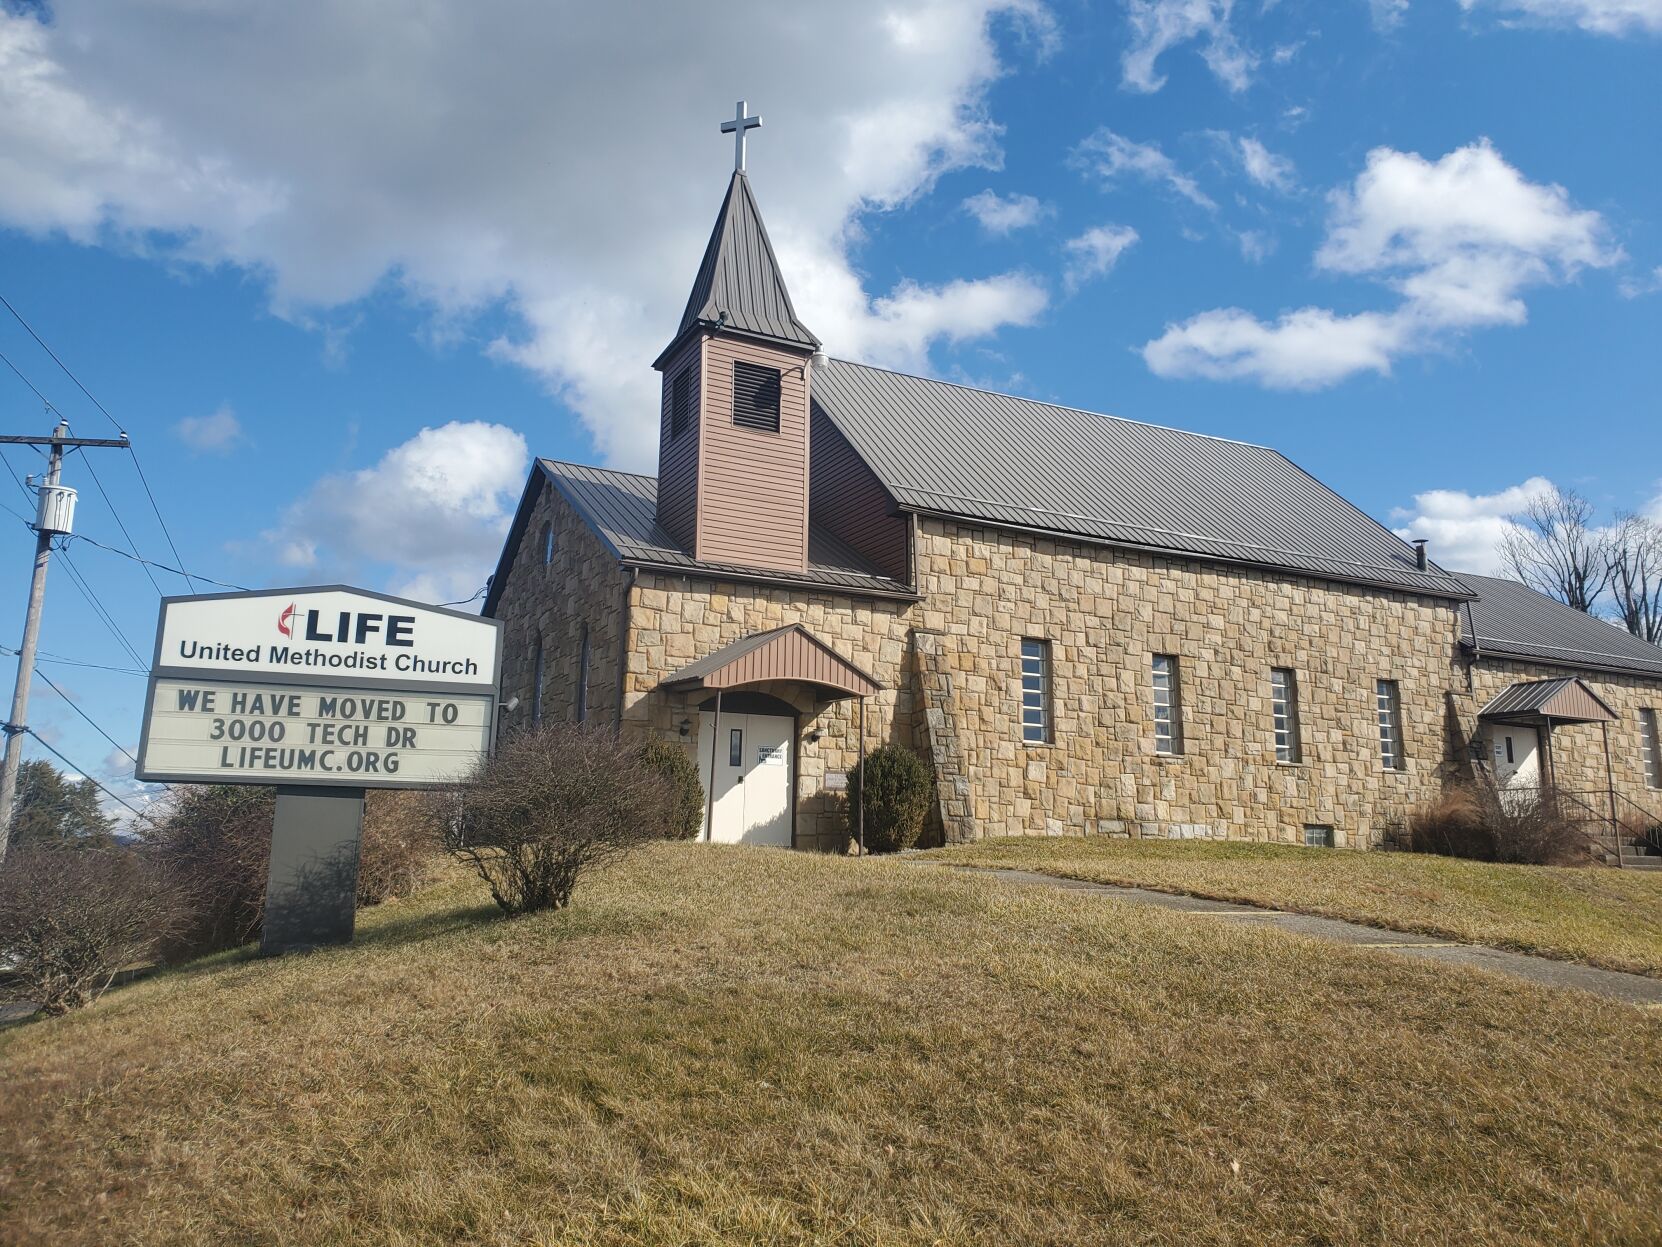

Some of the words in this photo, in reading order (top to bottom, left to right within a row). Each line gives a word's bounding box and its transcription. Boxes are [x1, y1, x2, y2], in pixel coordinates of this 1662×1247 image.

[306, 610, 416, 647] LIFE
[180, 641, 260, 662] United
[270, 646, 387, 670] Methodist
[395, 654, 478, 675] Church
[178, 690, 216, 713] WE
[231, 692, 301, 717] HAVE
[318, 697, 406, 721] MOVED
[427, 702, 458, 724] TO
[210, 718, 286, 743] 3000
[307, 723, 369, 747] TECH
[386, 727, 417, 749] DR
[221, 746, 399, 773] LIFEUMC.ORG
